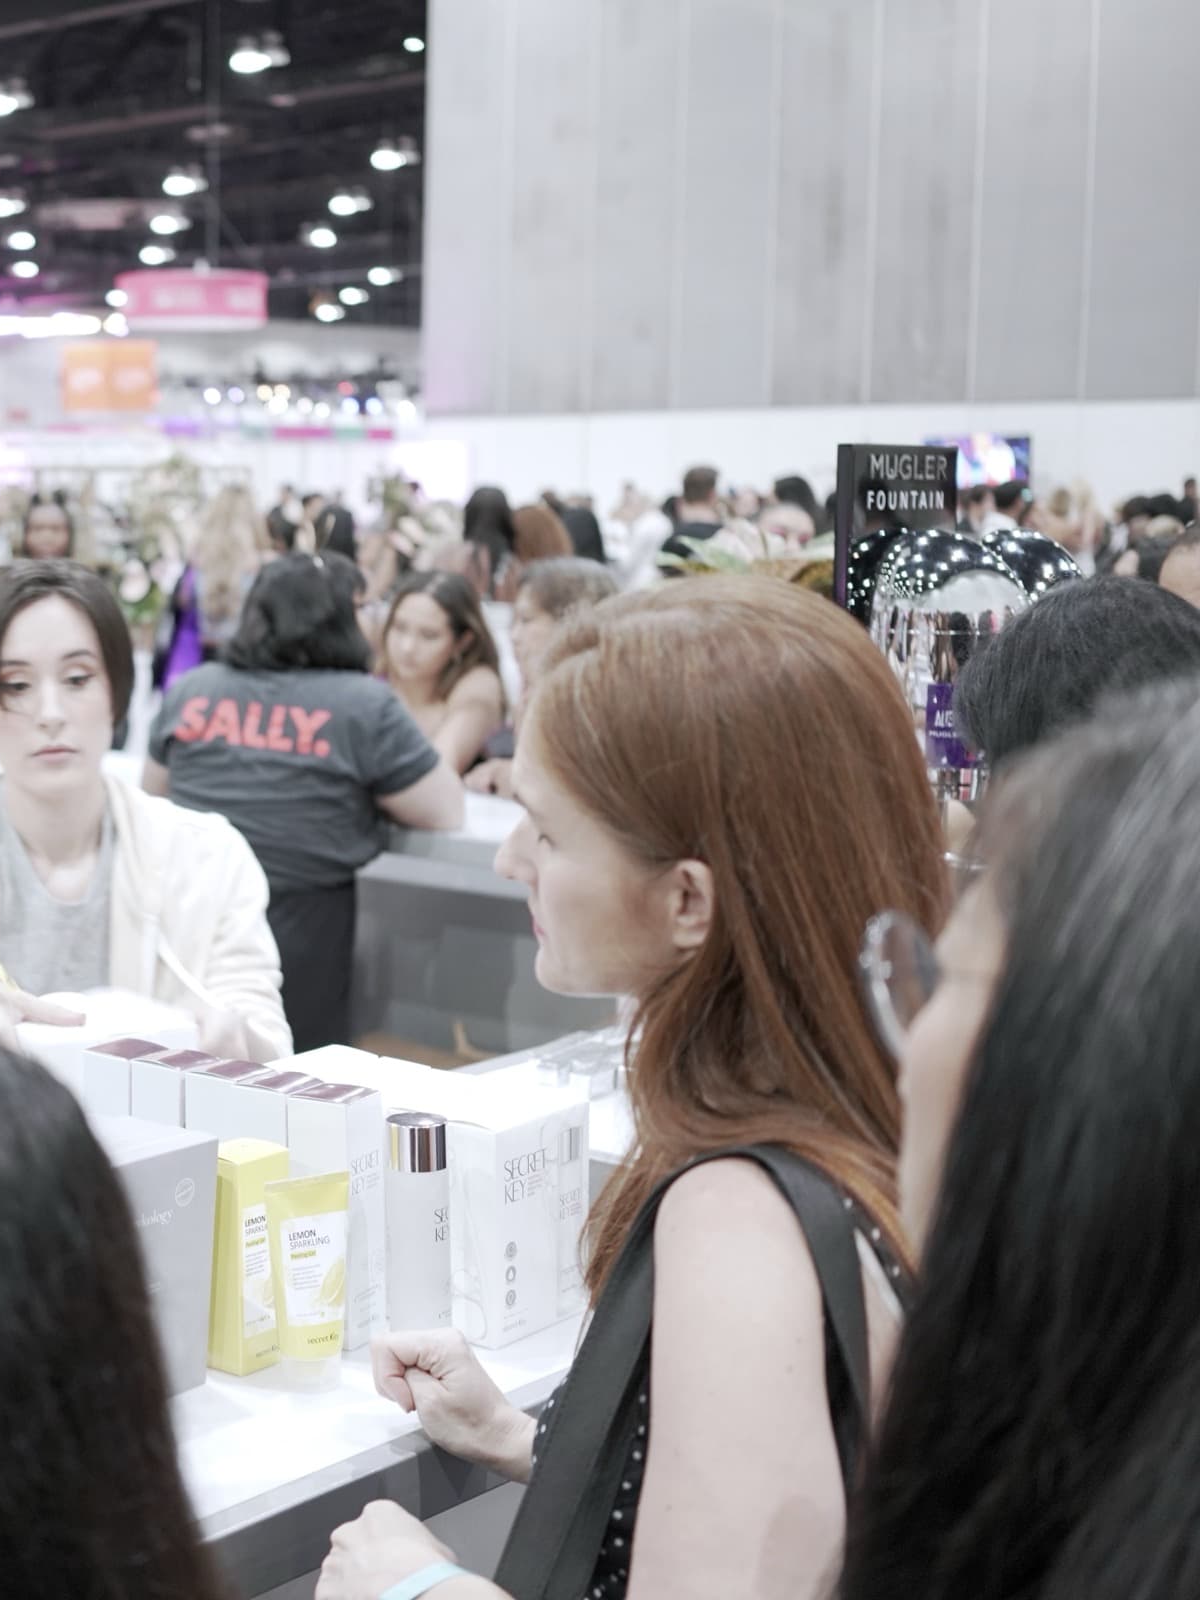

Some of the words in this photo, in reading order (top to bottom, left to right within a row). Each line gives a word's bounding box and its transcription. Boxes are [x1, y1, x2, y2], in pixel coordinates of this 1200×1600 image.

[869, 453, 948, 480] MUGLER
[866, 489, 945, 511] FOUNTAIN
[175, 695, 332, 758] SALLY.
[350, 1149, 380, 1175] SECRET
[504, 1148, 548, 1182] SECRET
[504, 1179, 528, 1206] KEY
[244, 1215, 266, 1228] LEMON
[433, 1206, 449, 1225] SEC
[288, 1229, 317, 1242] LEMON
[289, 1236, 331, 1250] SPARKLING
[434, 1225, 449, 1243] KE
